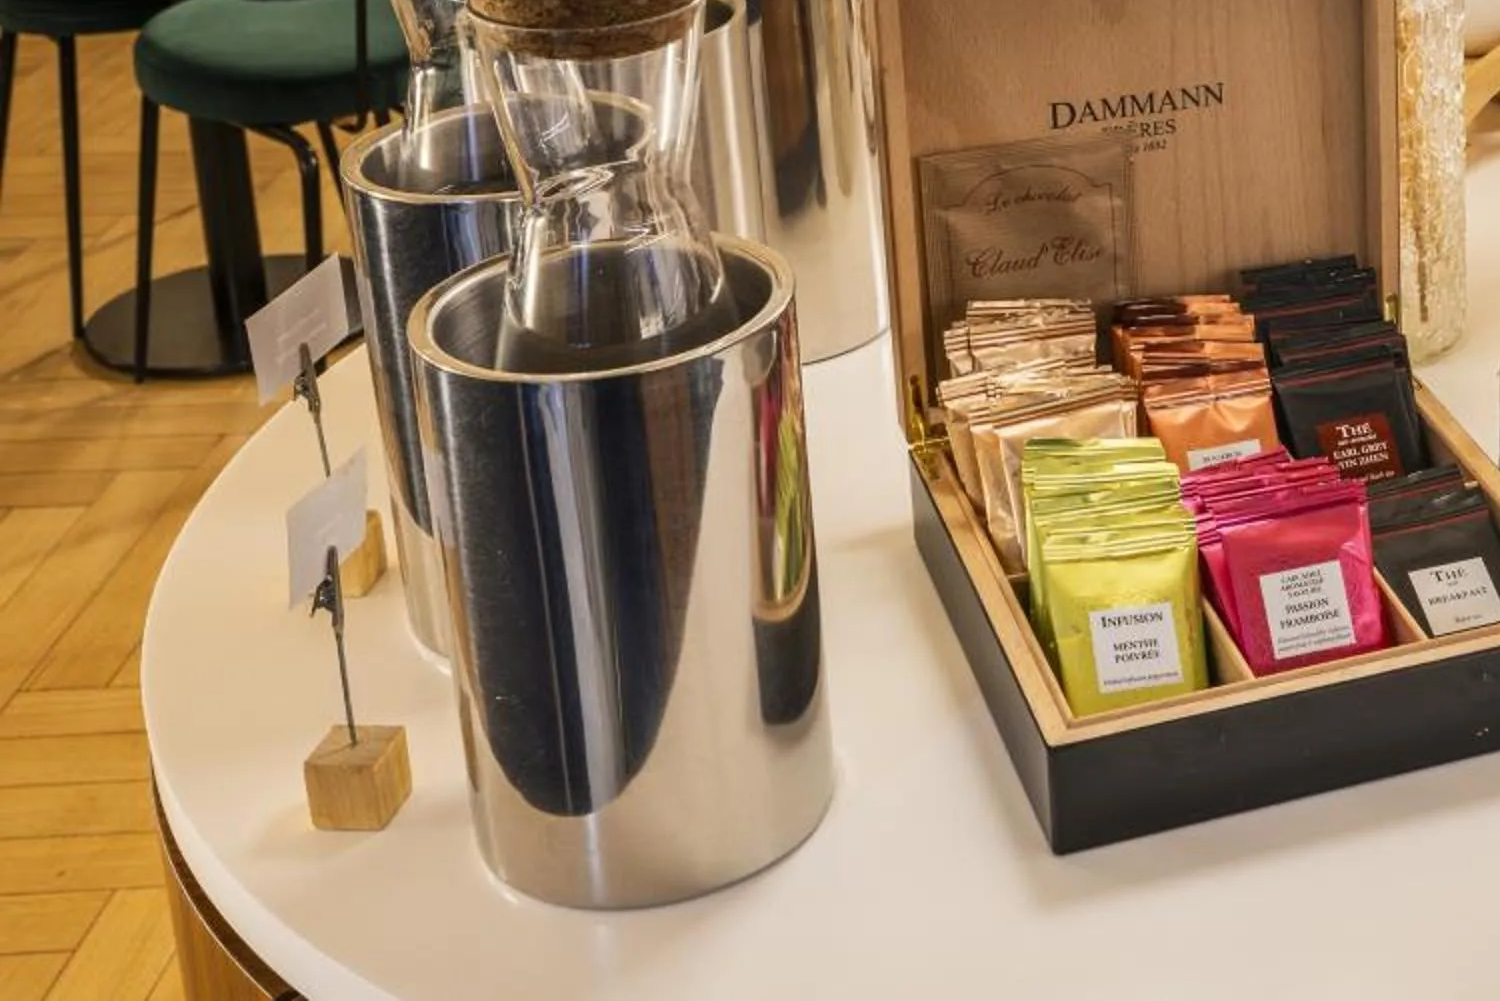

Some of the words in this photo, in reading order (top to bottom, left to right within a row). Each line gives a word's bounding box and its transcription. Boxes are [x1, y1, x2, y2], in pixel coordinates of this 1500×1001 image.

[1049, 82, 1225, 130] DAMMANN
[1361, 441, 1388, 454] GREY
[1428, 585, 1488, 605] BREAKFAST
[1285, 597, 1329, 614] PASSION
[1101, 610, 1164, 629] INFUSION
[1280, 608, 1340, 630] FRAMBOISE
[1113, 638, 1158, 652] MENTHE
